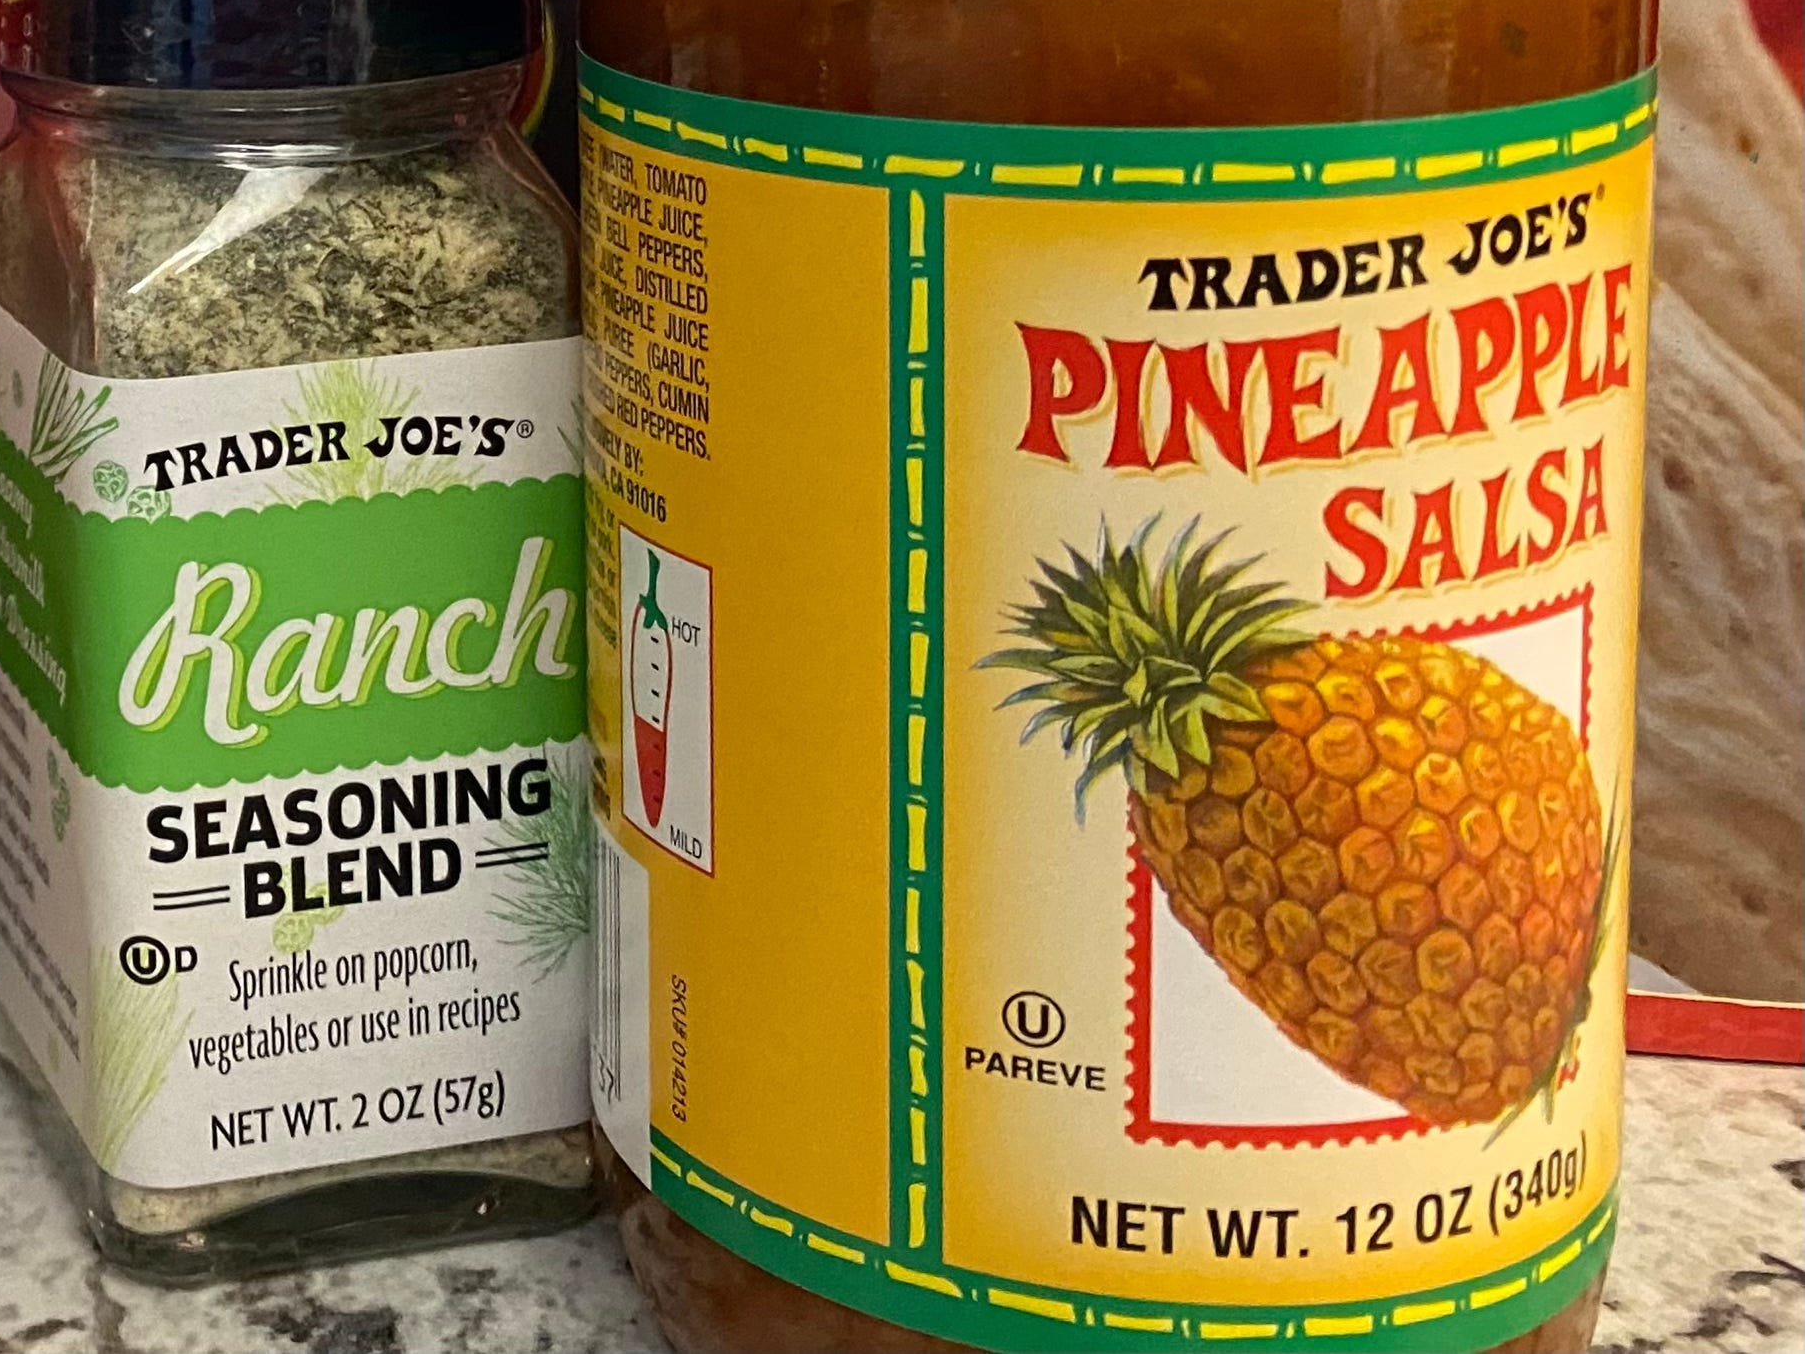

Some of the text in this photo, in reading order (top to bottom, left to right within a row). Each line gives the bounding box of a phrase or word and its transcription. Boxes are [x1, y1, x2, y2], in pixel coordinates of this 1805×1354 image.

[644, 162, 707, 206] TOMATO
[605, 219, 630, 253] BELL
[637, 231, 709, 283] PEPPERS,
[658, 206, 709, 246] JUICE,
[635, 265, 708, 315] DISTILLED
[1140, 232, 1427, 311] TRADER
[603, 314, 711, 393] PUREE (GARLIC,
[663, 315, 710, 352] JUICE
[1014, 263, 1636, 476] PINEAPPLE
[605, 352, 655, 406] PEPPERS,
[657, 380, 710, 425] CUMIN
[144, 420, 350, 493] TRADER
[616, 399, 639, 430] RED
[641, 410, 712, 462] PEPPERS.
[624, 442, 644, 477] BY:
[610, 466, 624, 495] CA
[627, 478, 667, 524] 91016
[1322, 434, 1608, 603] SALSA
[117, 535, 580, 747] Ranch
[670, 614, 701, 646] HOT
[145, 757, 552, 864] SEASONING
[669, 824, 703, 860] MILD
[243, 835, 463, 920] BLEND
[229, 938, 479, 1010] Sprinkle on popcorn,
[189, 989, 521, 1075] vegetables or use in recipes
[670, 973, 688, 1124] SKU# 014213
[964, 1047, 1107, 1093] PAREVE
[211, 1071, 506, 1150] NET WT. 2 OZ (57g)
[1070, 1131, 1588, 1259] NET WT. 12 OZ (340g)
